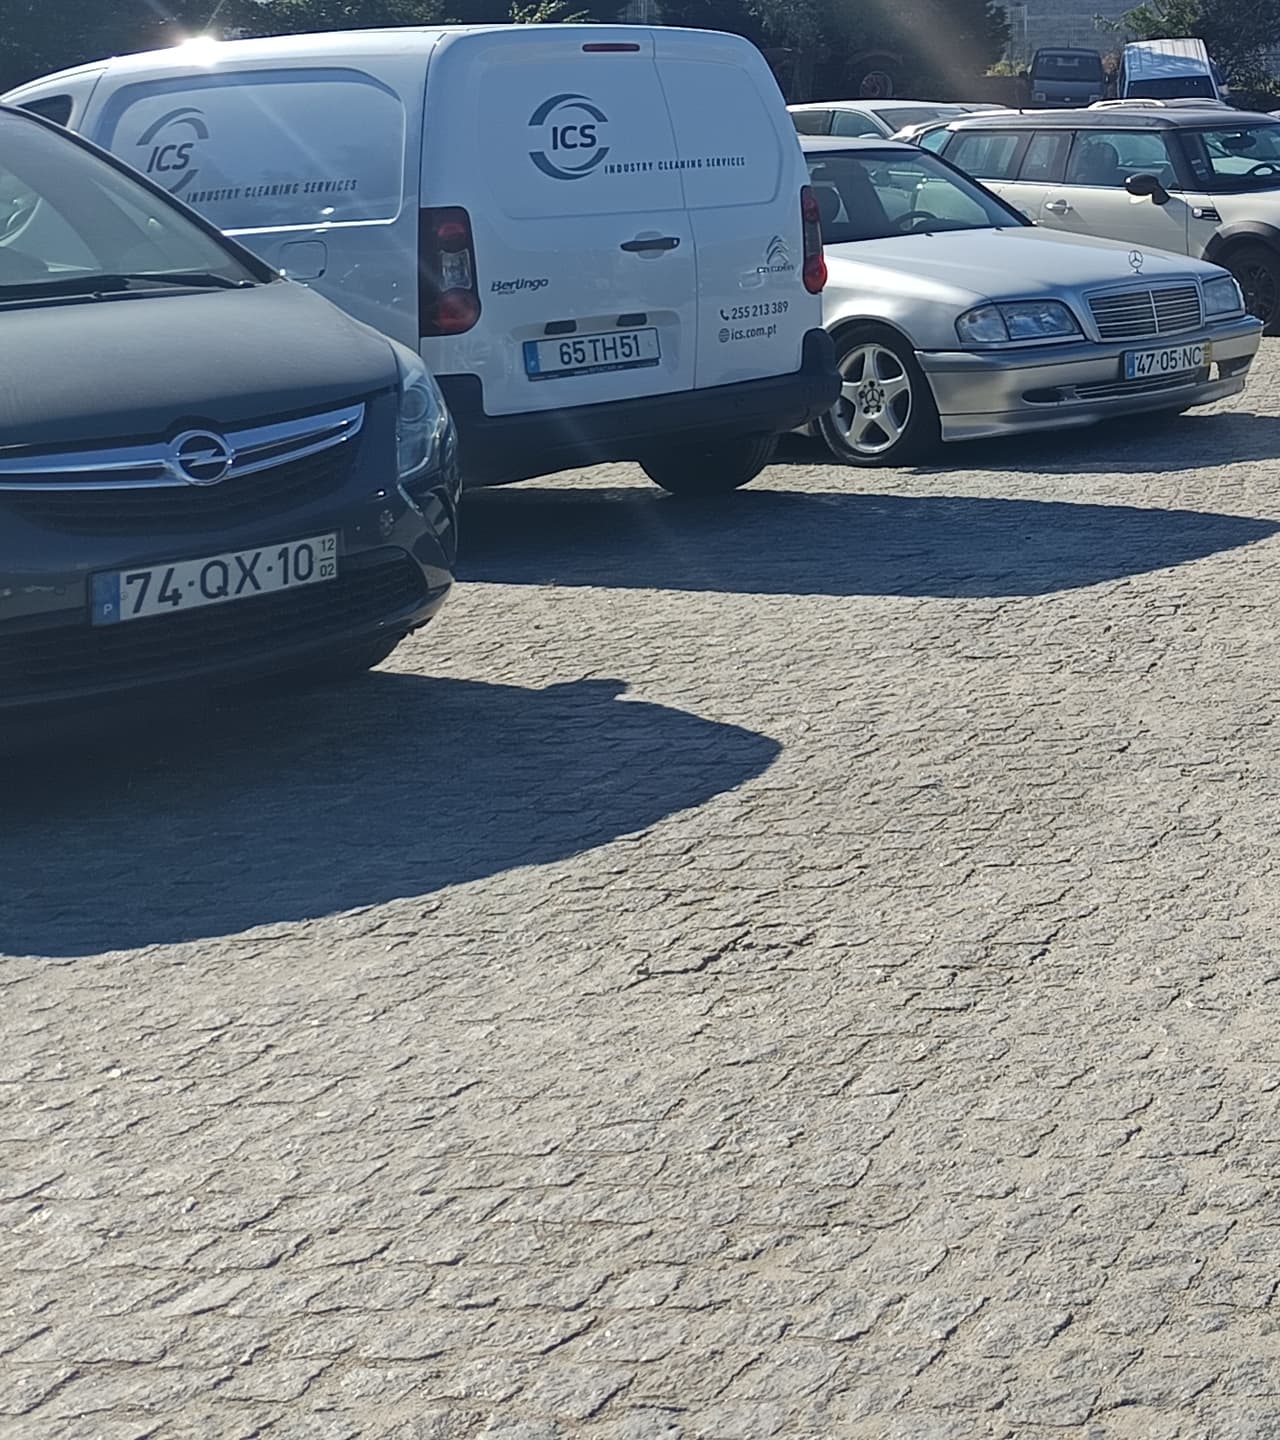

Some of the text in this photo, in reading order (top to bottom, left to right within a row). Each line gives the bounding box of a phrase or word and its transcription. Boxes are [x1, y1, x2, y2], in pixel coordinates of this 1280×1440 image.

[552, 124, 597, 150] ICS
[147, 143, 194, 173] ICS
[604, 156, 746, 175] INDUSTRY CLEANING SERVICES
[187, 178, 358, 204] INDUSTRY CLEANING SERVICES
[490, 277, 549, 292] Berlingo
[731, 305, 750, 320] 255
[752, 303, 770, 317] 213
[730, 323, 777, 340] ics.com.pt
[320, 537, 335, 553] 12
[320, 562, 335, 578] 02
[103, 603, 113, 615] P
